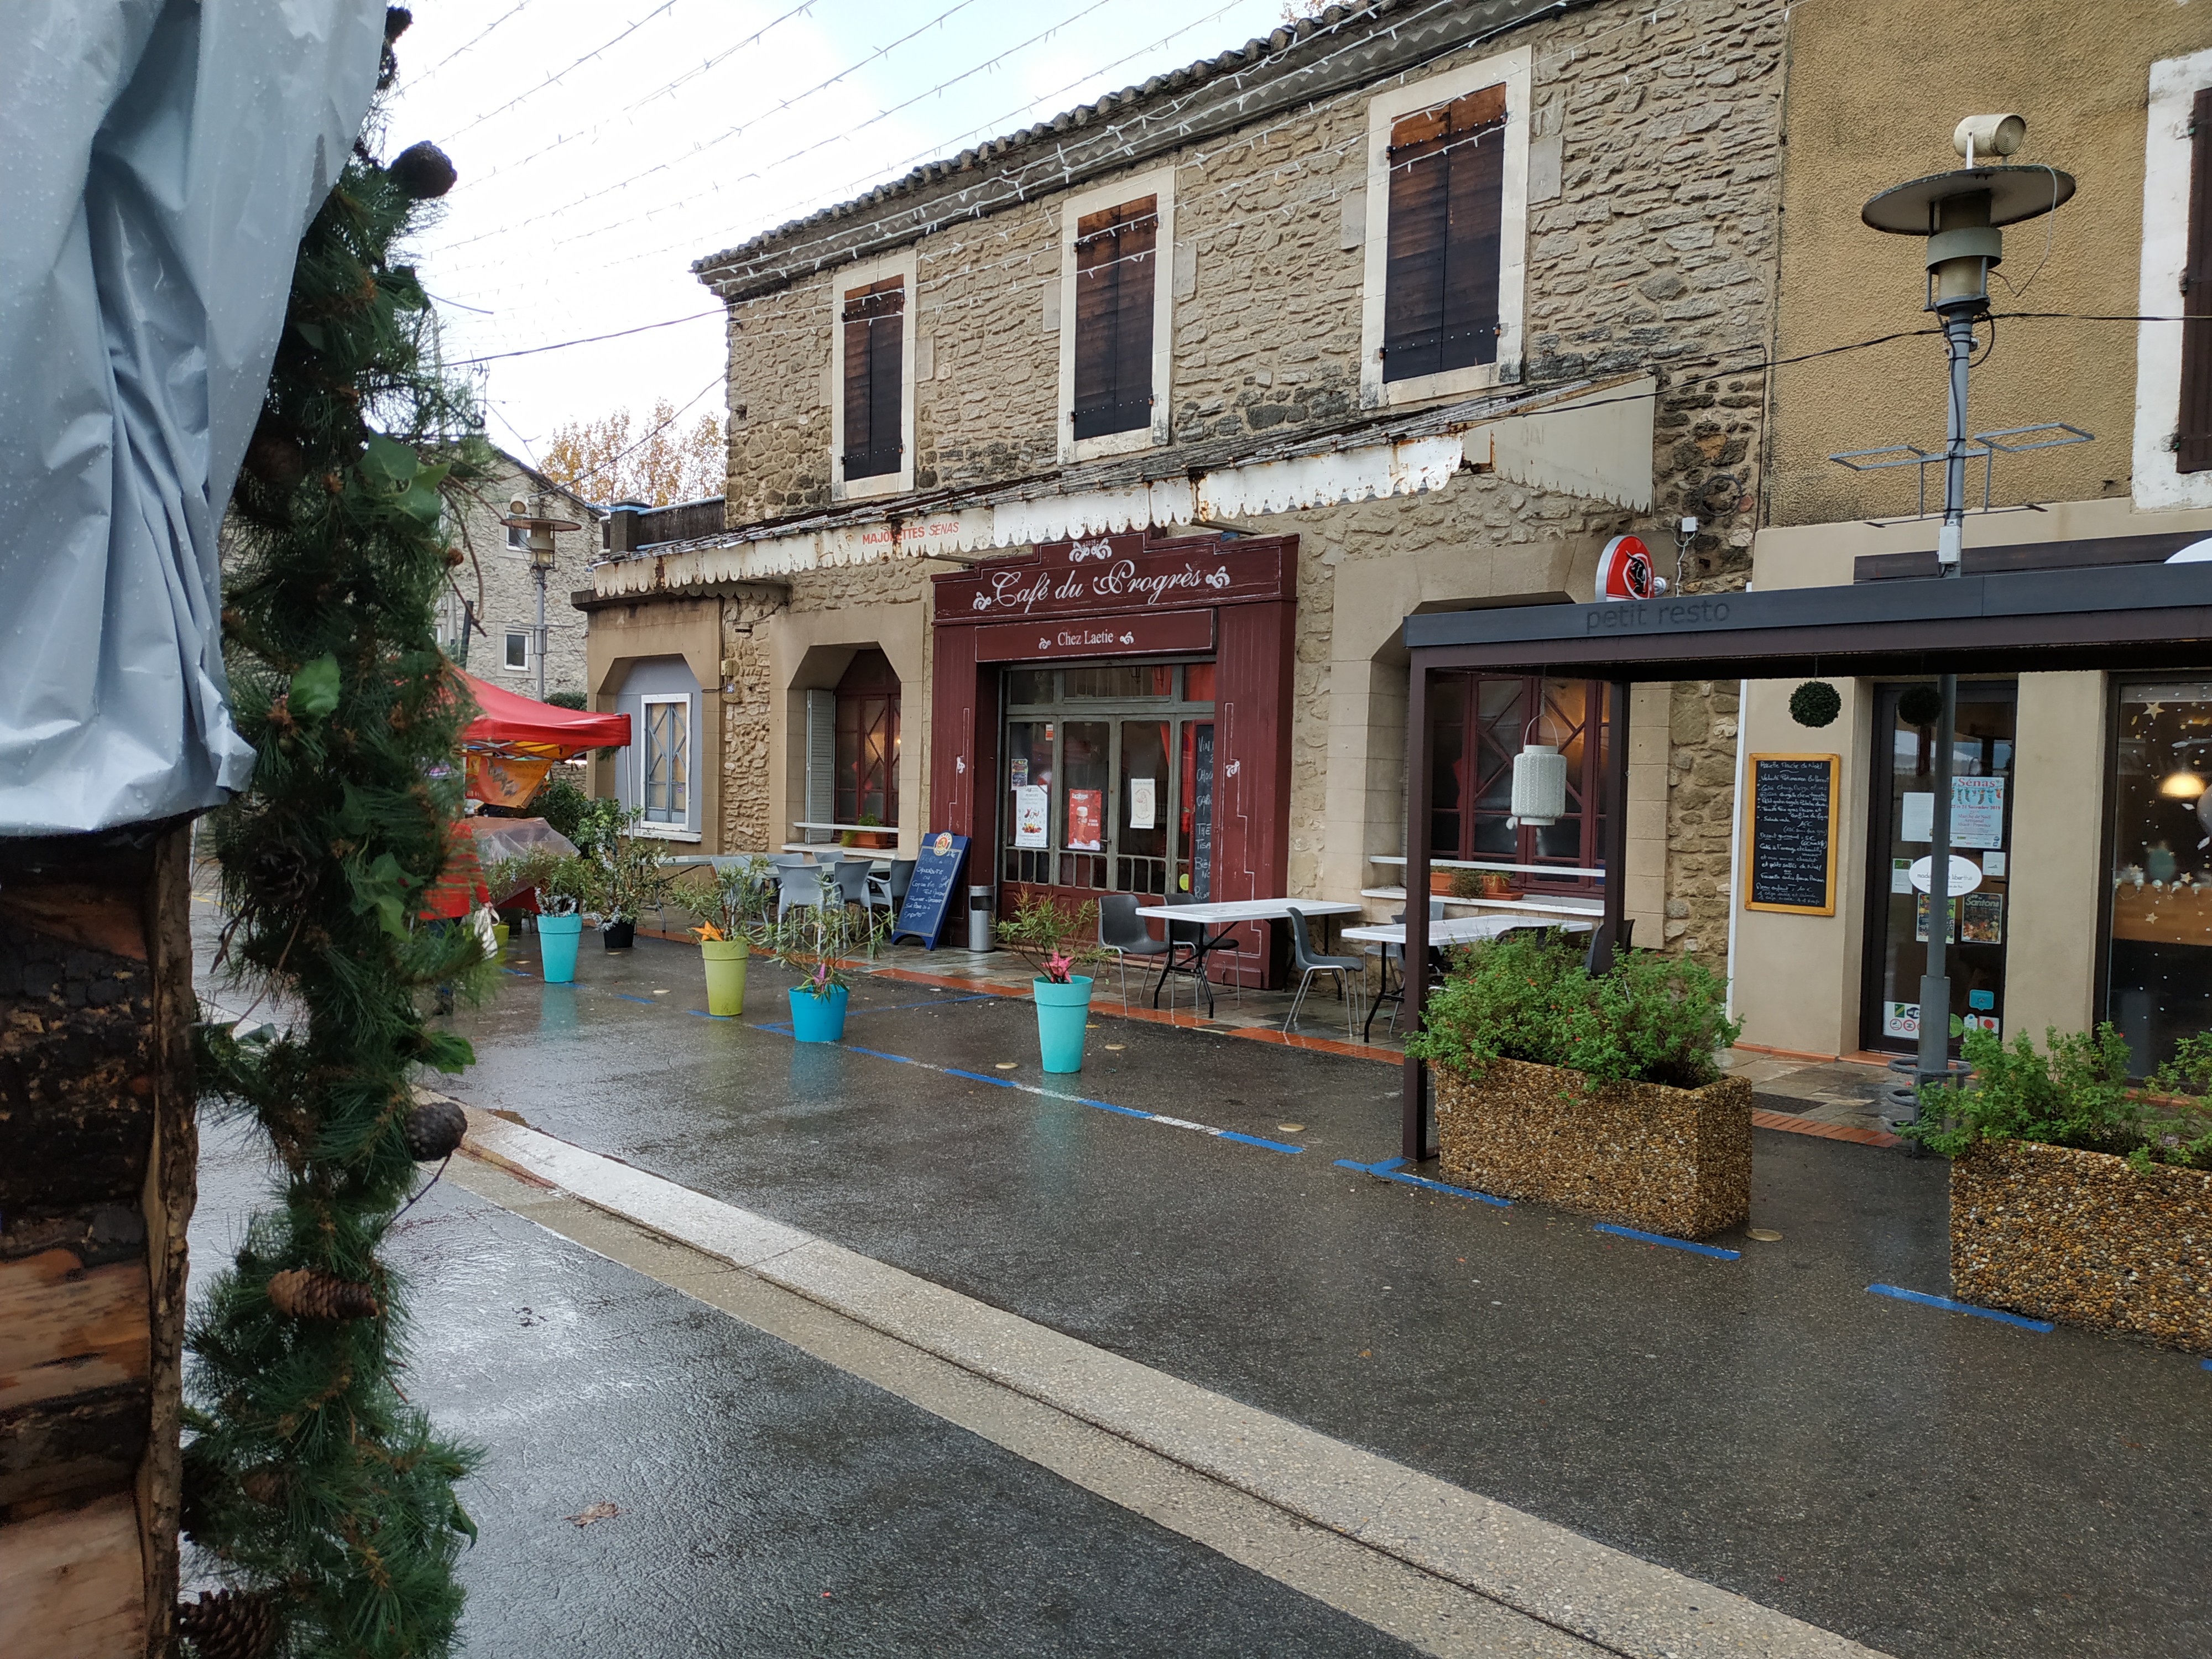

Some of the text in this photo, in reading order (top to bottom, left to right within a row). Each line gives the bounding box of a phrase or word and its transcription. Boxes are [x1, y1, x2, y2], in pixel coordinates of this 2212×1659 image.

[993, 560, 1202, 613] Café du Progrès
[1587, 600, 1730, 635] petit resto
[1057, 630, 1113, 646] Chez Laetie
[1958, 778, 1996, 787] Sénas
[1965, 898, 2000, 907] Santons
